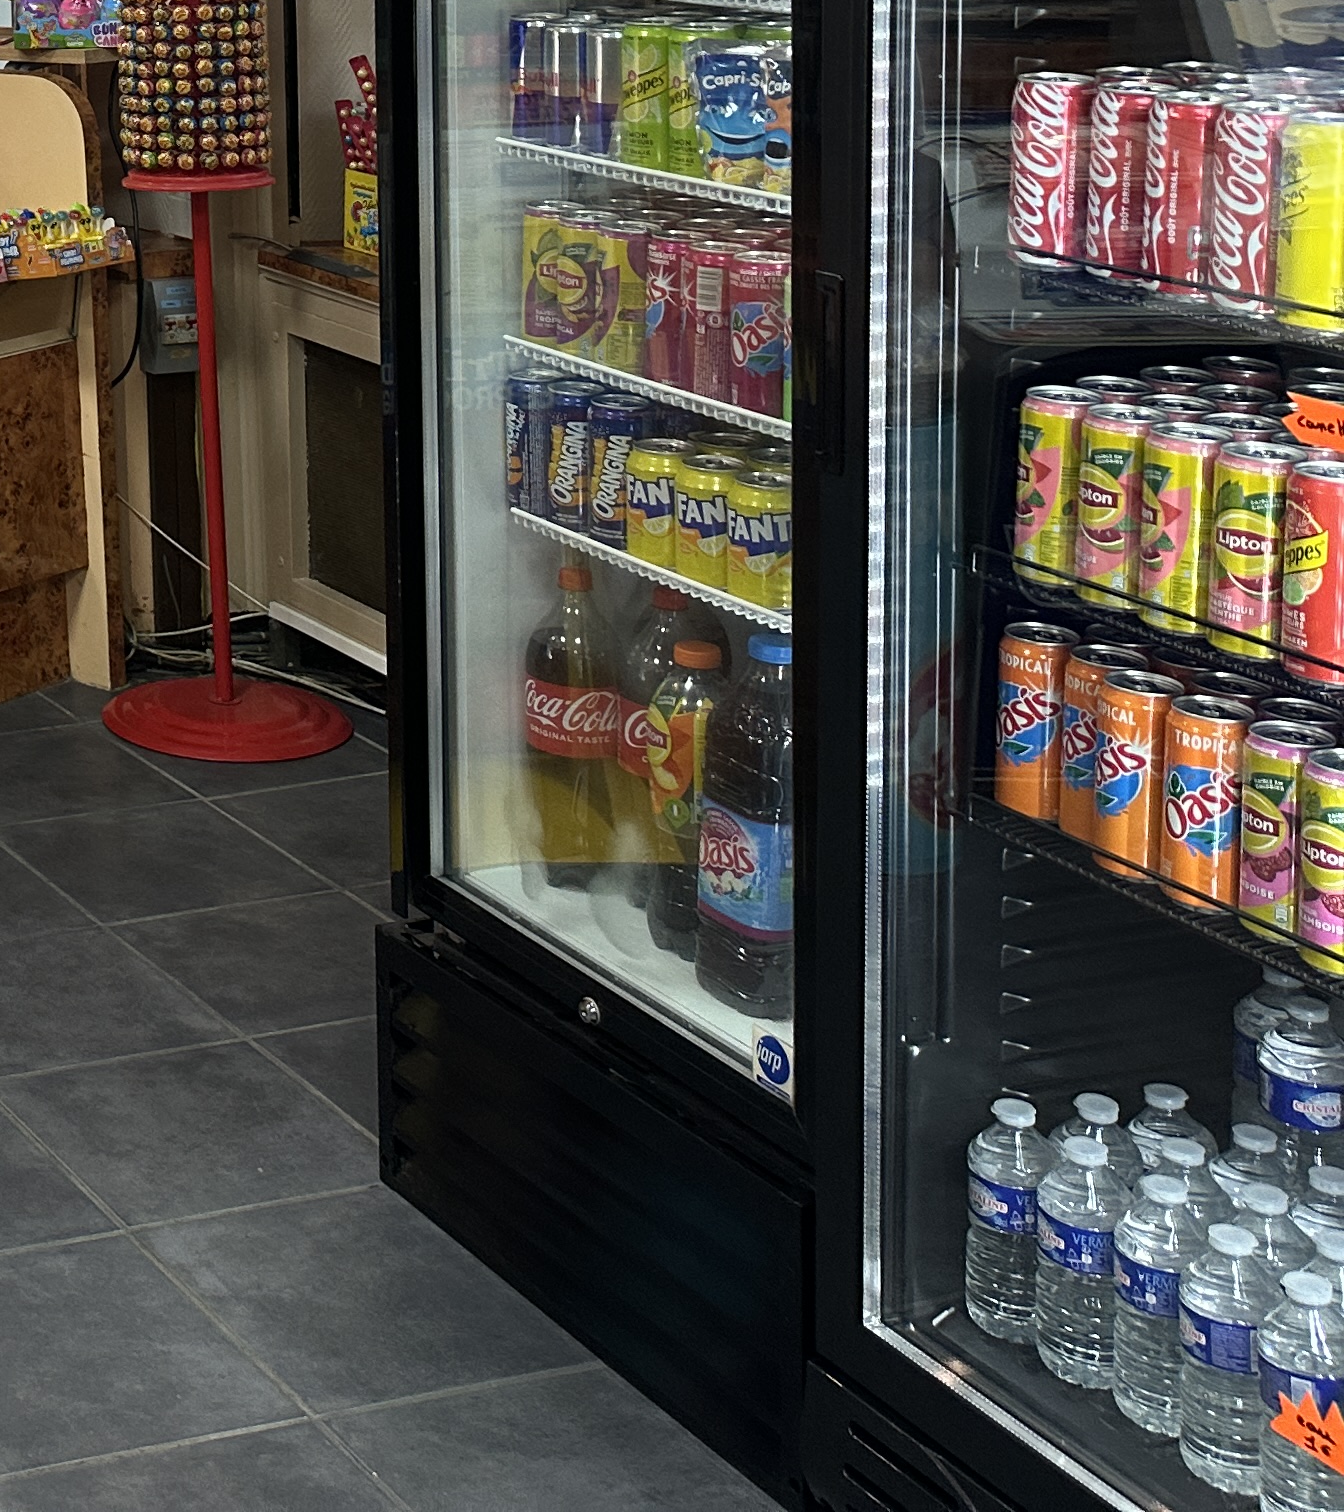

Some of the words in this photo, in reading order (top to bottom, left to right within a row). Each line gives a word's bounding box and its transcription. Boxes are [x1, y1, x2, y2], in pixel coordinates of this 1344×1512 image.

[702, 72, 765, 91] Capri-S
[550, 420, 590, 505] ORANGINA
[592, 434, 633, 521] ORANGINA
[727, 508, 792, 544] FANT
[1218, 529, 1273, 557] Lipton
[524, 678, 620, 734] Coca-Cola
[698, 833, 756, 875] Oasis
